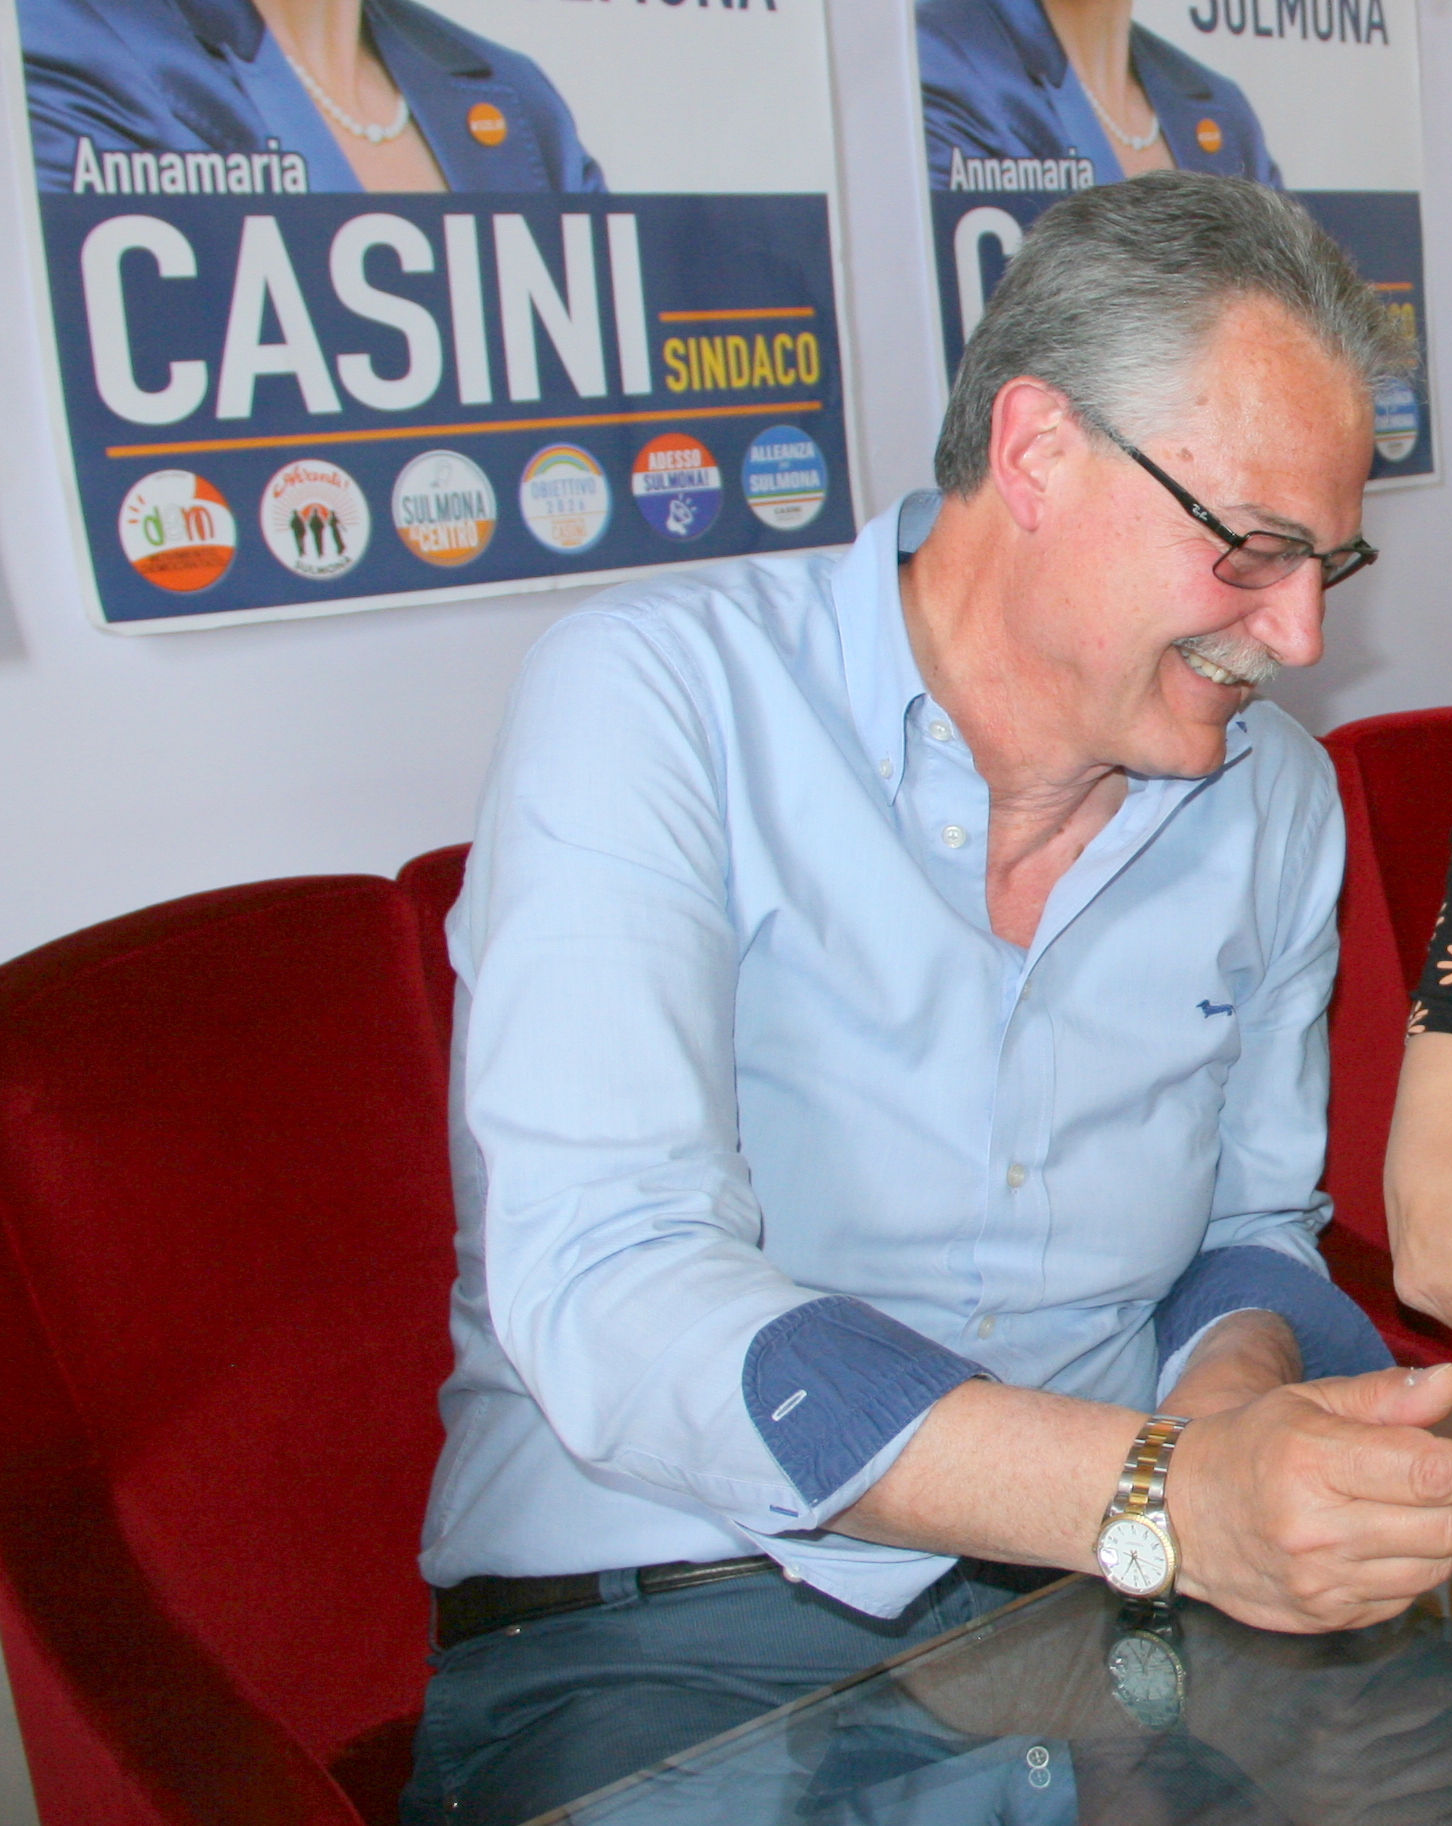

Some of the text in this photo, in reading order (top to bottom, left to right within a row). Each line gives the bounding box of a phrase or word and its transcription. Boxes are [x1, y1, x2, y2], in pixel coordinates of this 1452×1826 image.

[73, 137, 308, 194] Annamaria
[949, 146, 1095, 191] Annamaria
[81, 212, 653, 425] CASINI
[663, 332, 821, 394] SINDACO
[648, 449, 703, 471] ADESSO
[750, 441, 815, 462] ALLEANZA
[749, 469, 820, 493] SULMONA
[402, 489, 489, 525] SULMONA
[419, 520, 479, 553] CENTRO
